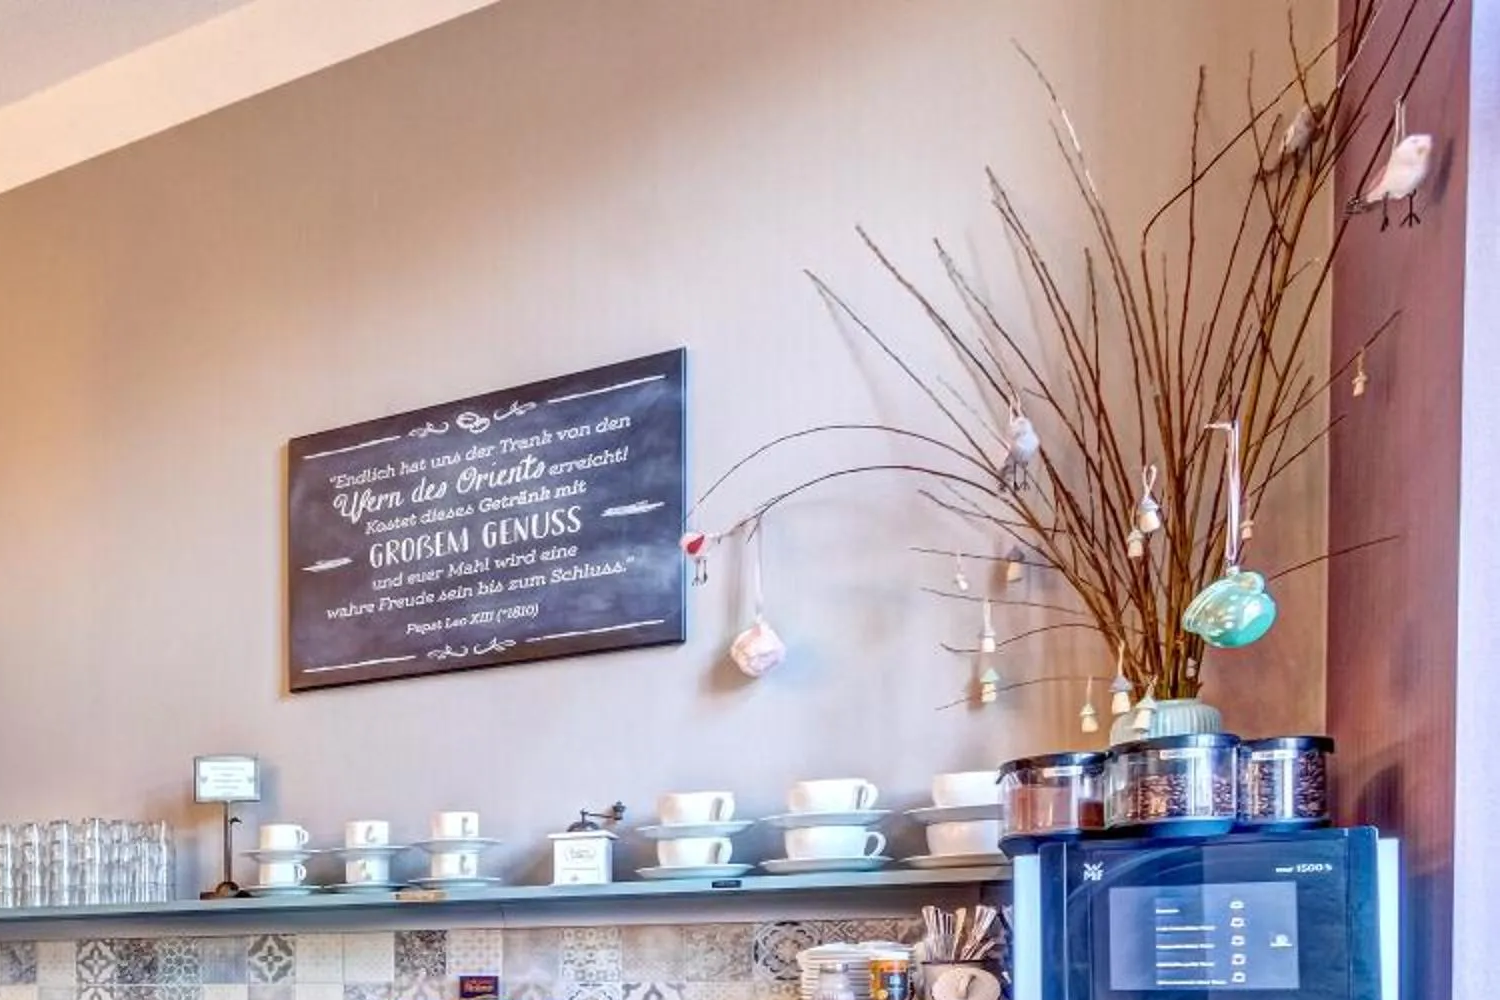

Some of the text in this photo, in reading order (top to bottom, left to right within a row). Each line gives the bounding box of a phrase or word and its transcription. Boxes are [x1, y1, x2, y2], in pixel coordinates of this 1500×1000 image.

[400, 461, 427, 475] hat
[431, 451, 461, 468] uns
[465, 445, 496, 461] der
[500, 429, 553, 455] Trank
[556, 425, 591, 441] von
[595, 415, 631, 433] den
[332, 446, 629, 525] Ufern des Orients erreicht!
[364, 479, 588, 535] Kostet dieses Getränk mit
[482, 505, 582, 549] GENUSS
[372, 544, 579, 591] und euer Mahl wird eine
[326, 602, 376, 620] wahre
[378, 591, 435, 612] Freude
[436, 585, 473, 603] sein
[478, 579, 505, 596] bis
[507, 574, 547, 591] zum
[405, 619, 443, 635] Papst
[444, 617, 467, 629] Leo
[469, 611, 494, 626] XIII
